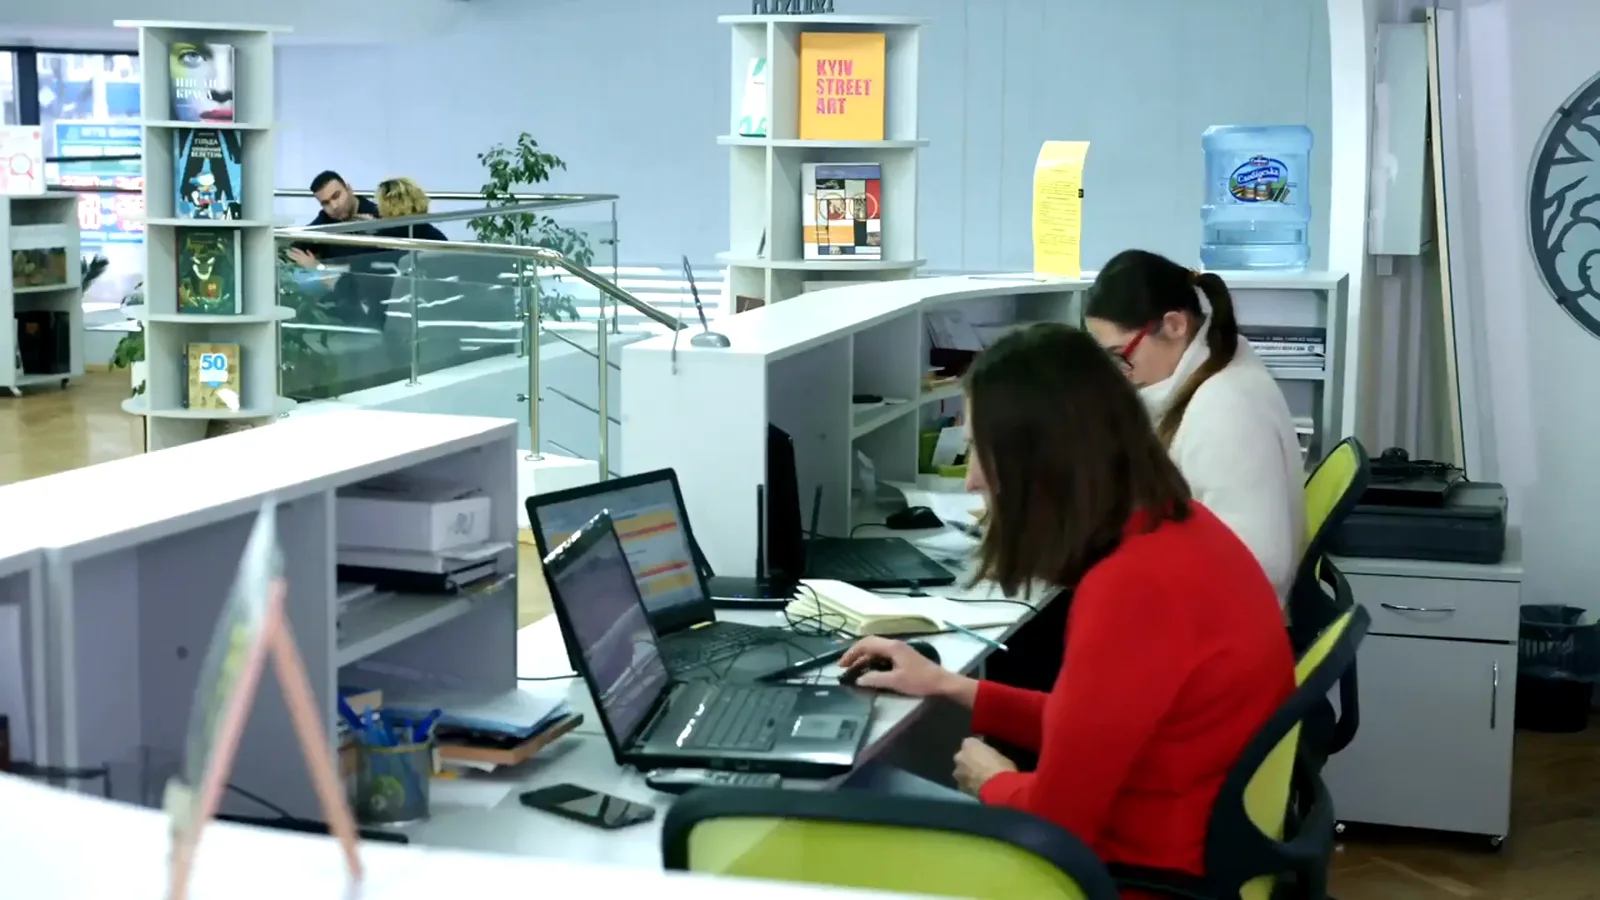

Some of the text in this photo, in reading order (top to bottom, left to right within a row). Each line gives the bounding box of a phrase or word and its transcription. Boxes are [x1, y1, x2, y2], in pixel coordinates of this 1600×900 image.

[817, 59, 853, 76] KYIV
[816, 78, 871, 95] STREET
[816, 97, 846, 115] ART
[202, 354, 225, 371] 50
